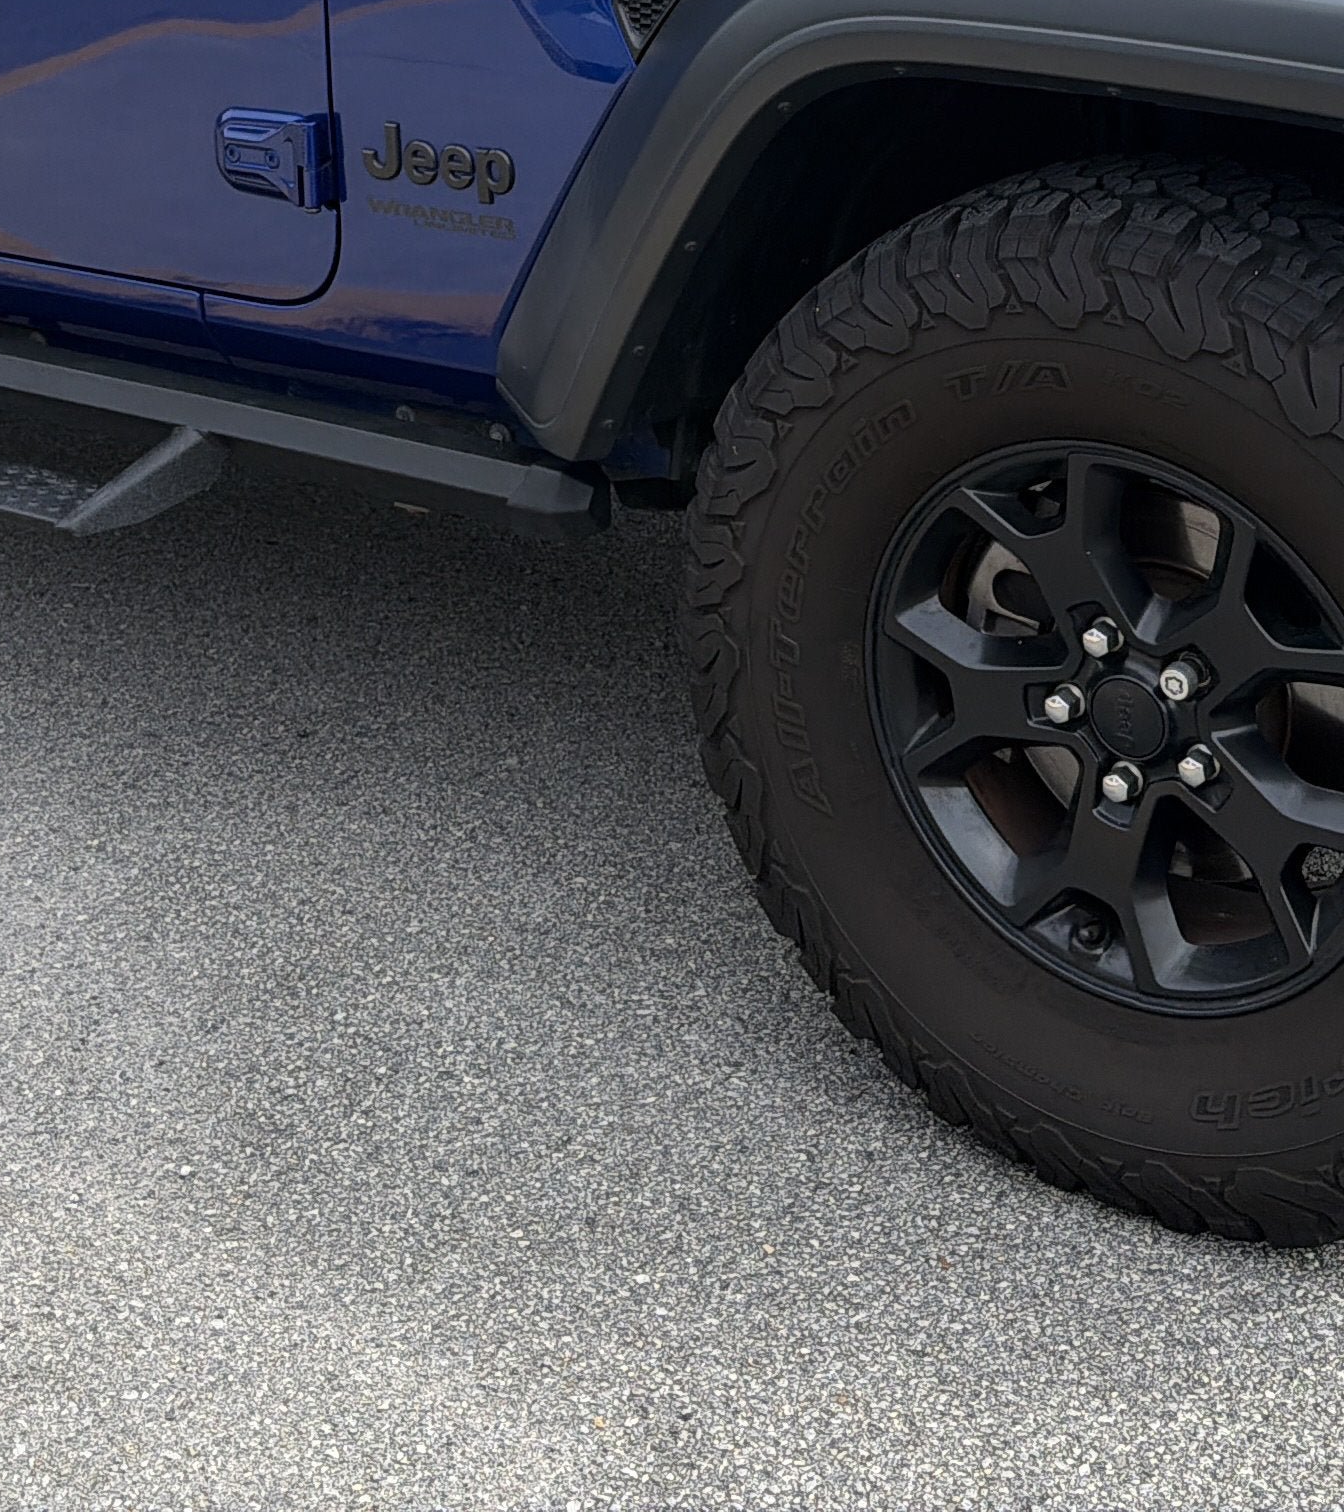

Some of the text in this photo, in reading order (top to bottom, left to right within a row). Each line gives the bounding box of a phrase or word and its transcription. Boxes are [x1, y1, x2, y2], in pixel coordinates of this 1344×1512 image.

[361, 120, 516, 205] Jeep
[367, 198, 515, 232] WRANGLER
[943, 359, 1075, 403] T/A
